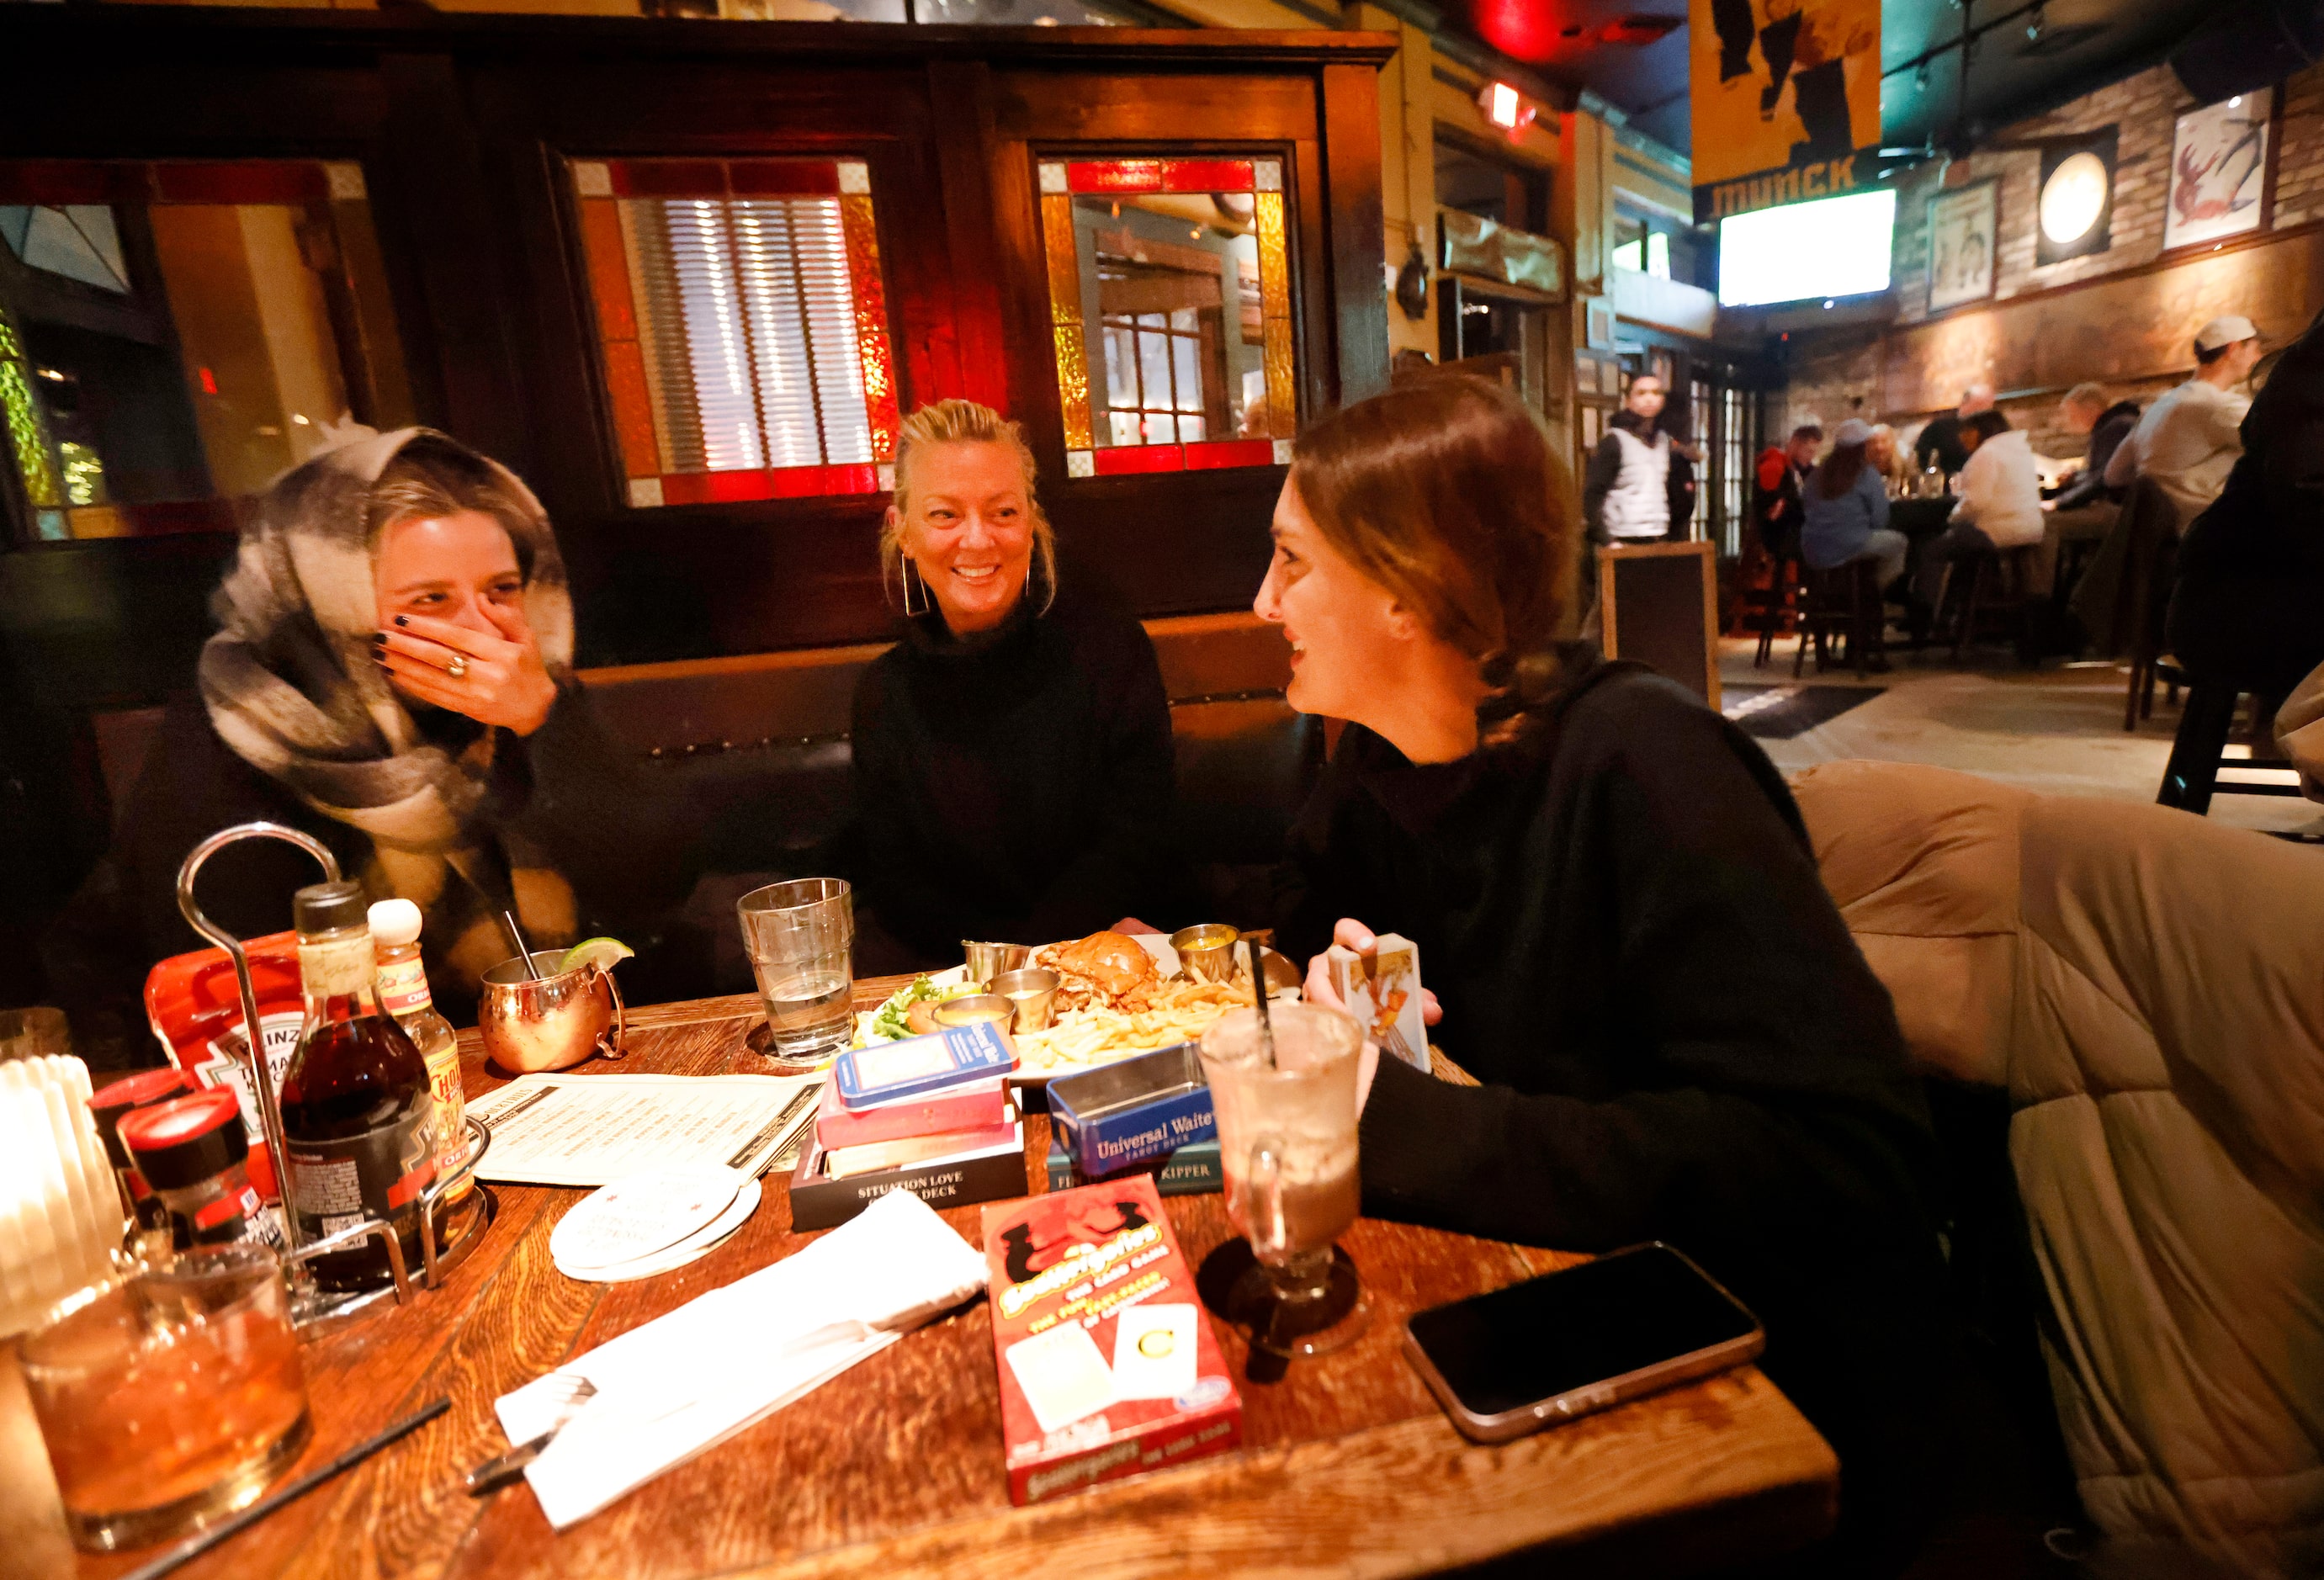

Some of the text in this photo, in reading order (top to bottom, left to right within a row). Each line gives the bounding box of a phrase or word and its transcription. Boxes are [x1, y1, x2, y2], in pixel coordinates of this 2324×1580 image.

[1096, 1121, 1169, 1159] Universal
[1124, 1134, 1190, 1162] TAROT DECK
[857, 1170, 964, 1199] SITUATION LOVE
[1161, 1164, 1212, 1180] KIPPER
[921, 1185, 957, 1201] DECK
